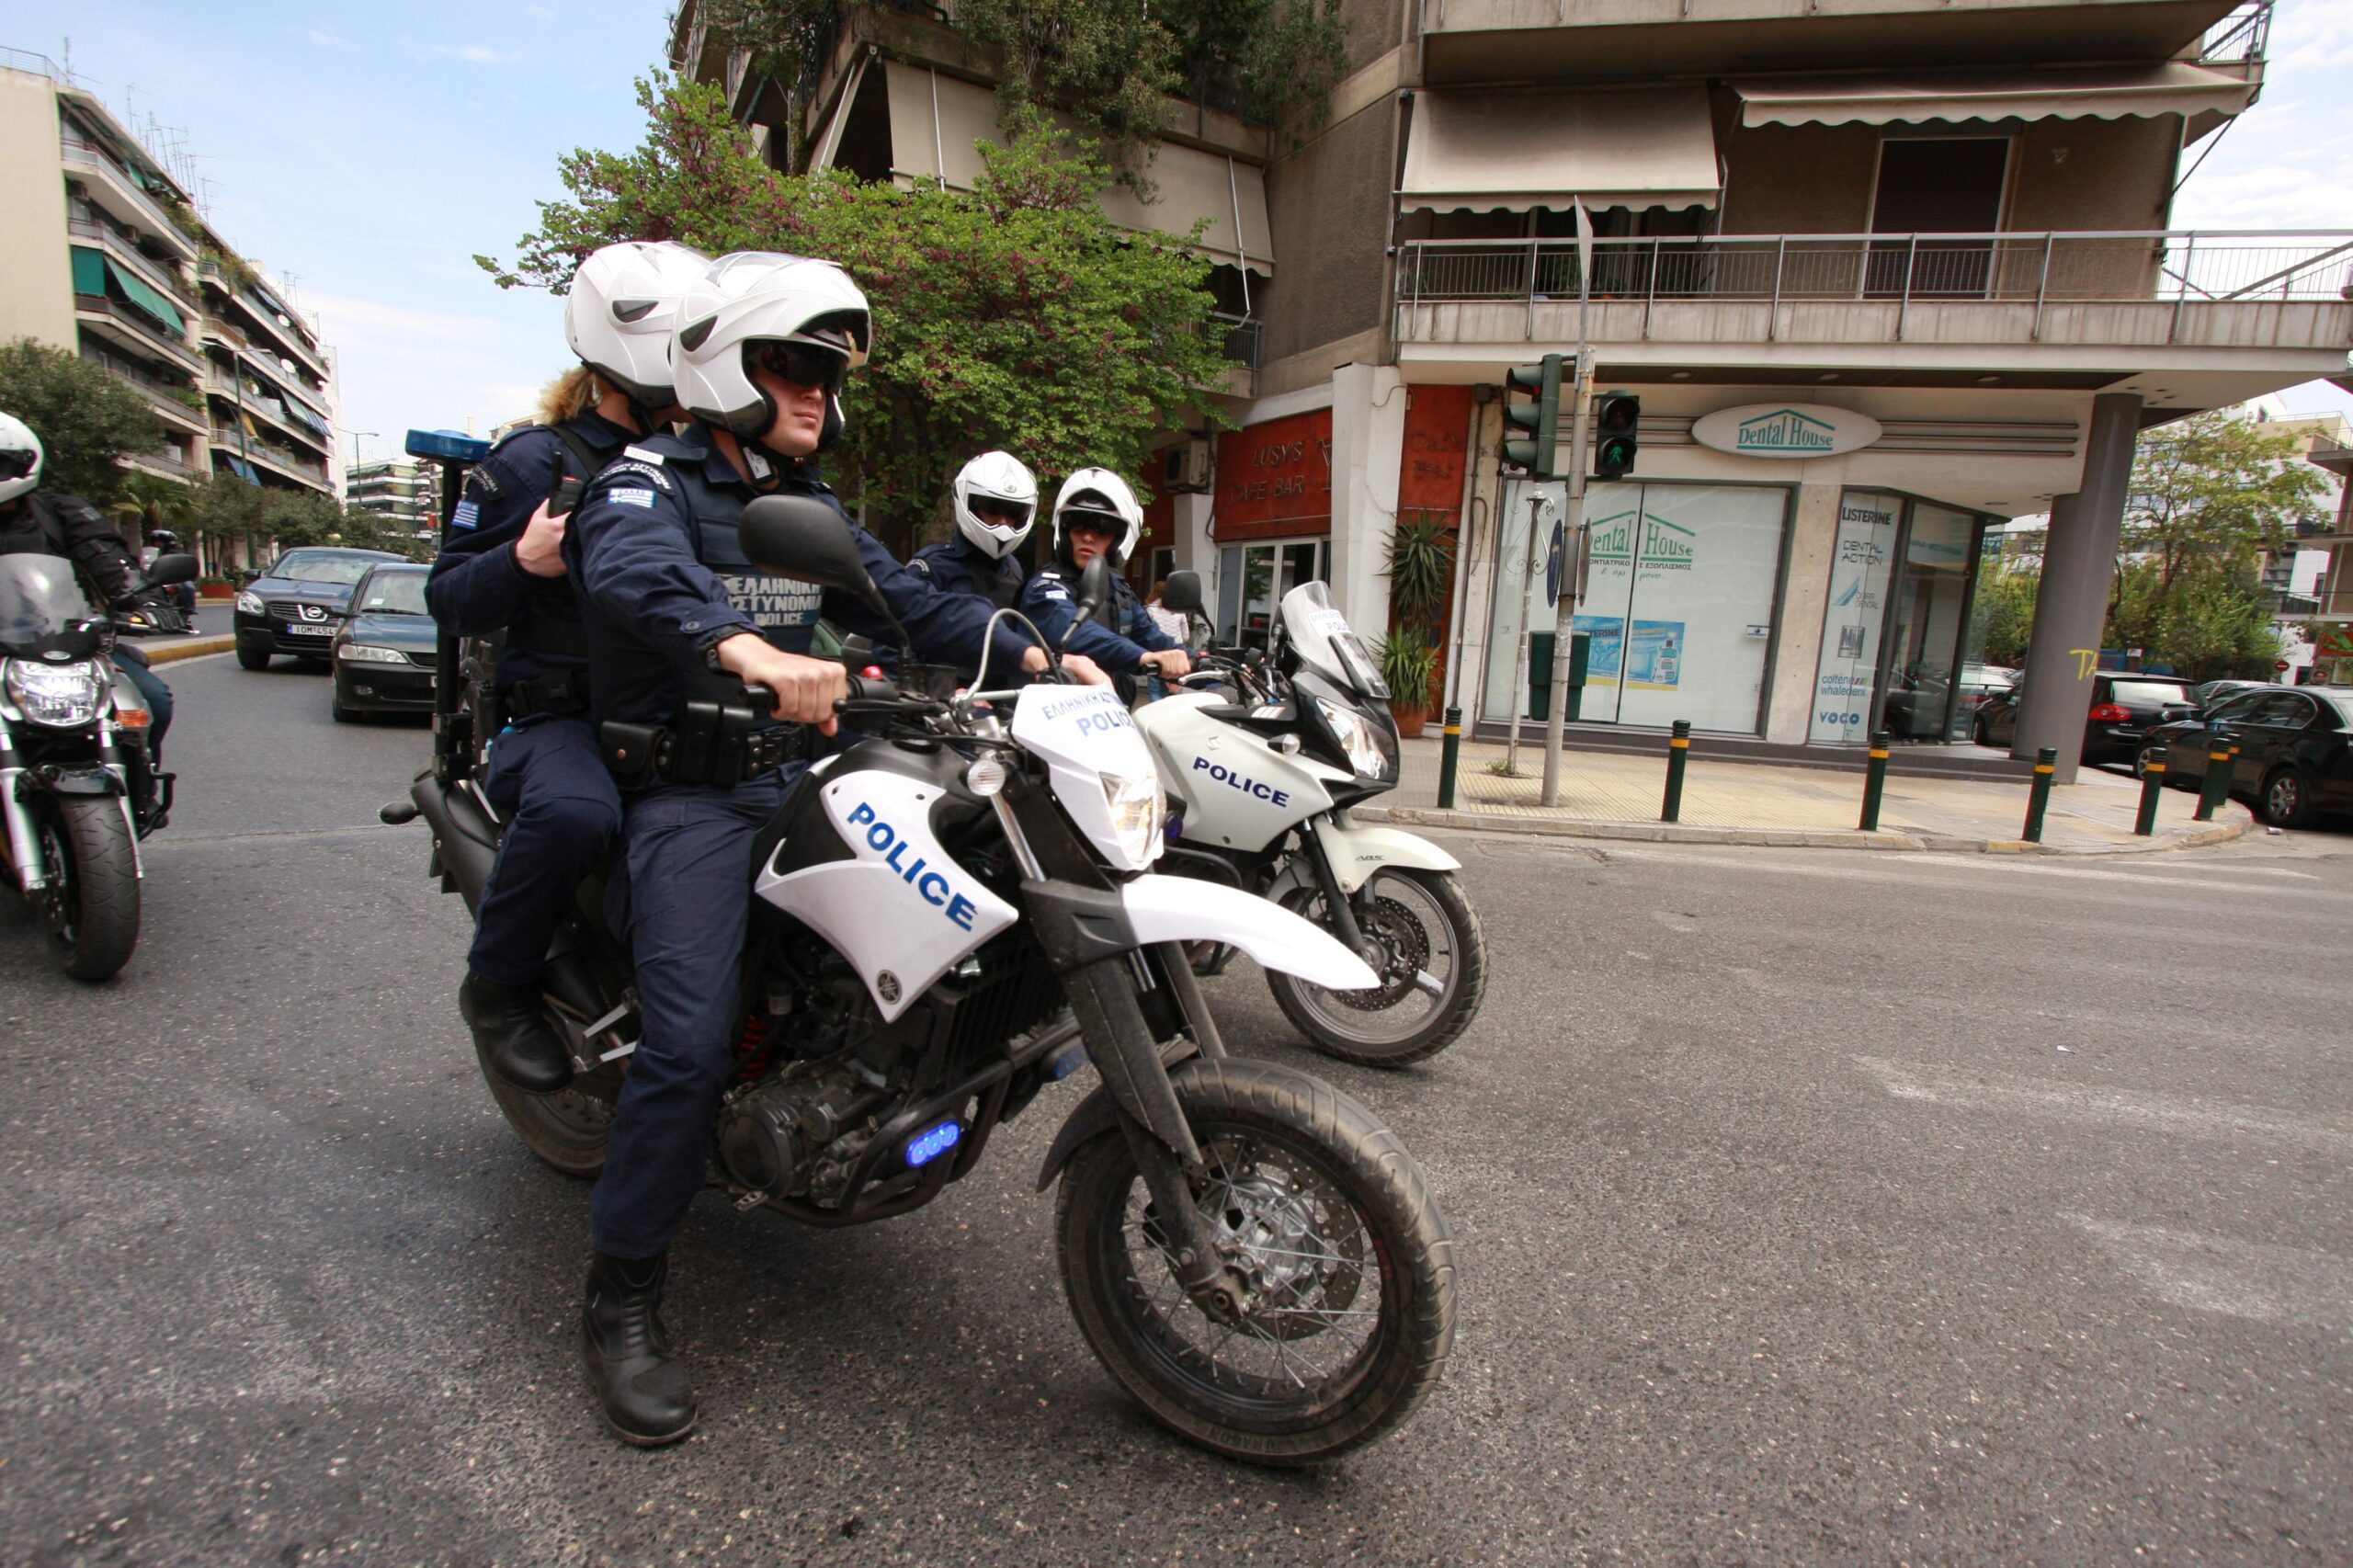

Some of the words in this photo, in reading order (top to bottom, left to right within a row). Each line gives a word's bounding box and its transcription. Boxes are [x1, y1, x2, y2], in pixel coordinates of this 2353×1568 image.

[1738, 415, 1787, 444] Dental
[1789, 417, 1833, 446] House
[1841, 507, 1893, 526] LISTERINE
[1590, 519, 1632, 552] ental
[1643, 522, 1693, 557] House
[1843, 540, 1883, 554] DENTAL
[1841, 553, 1882, 566] ACTION
[754, 613, 804, 626] POLICE
[1589, 628, 1620, 638] TERINE
[1820, 685, 1866, 697] whaledent
[1193, 756, 1290, 808] POLICE
[847, 801, 977, 932] POLICE
